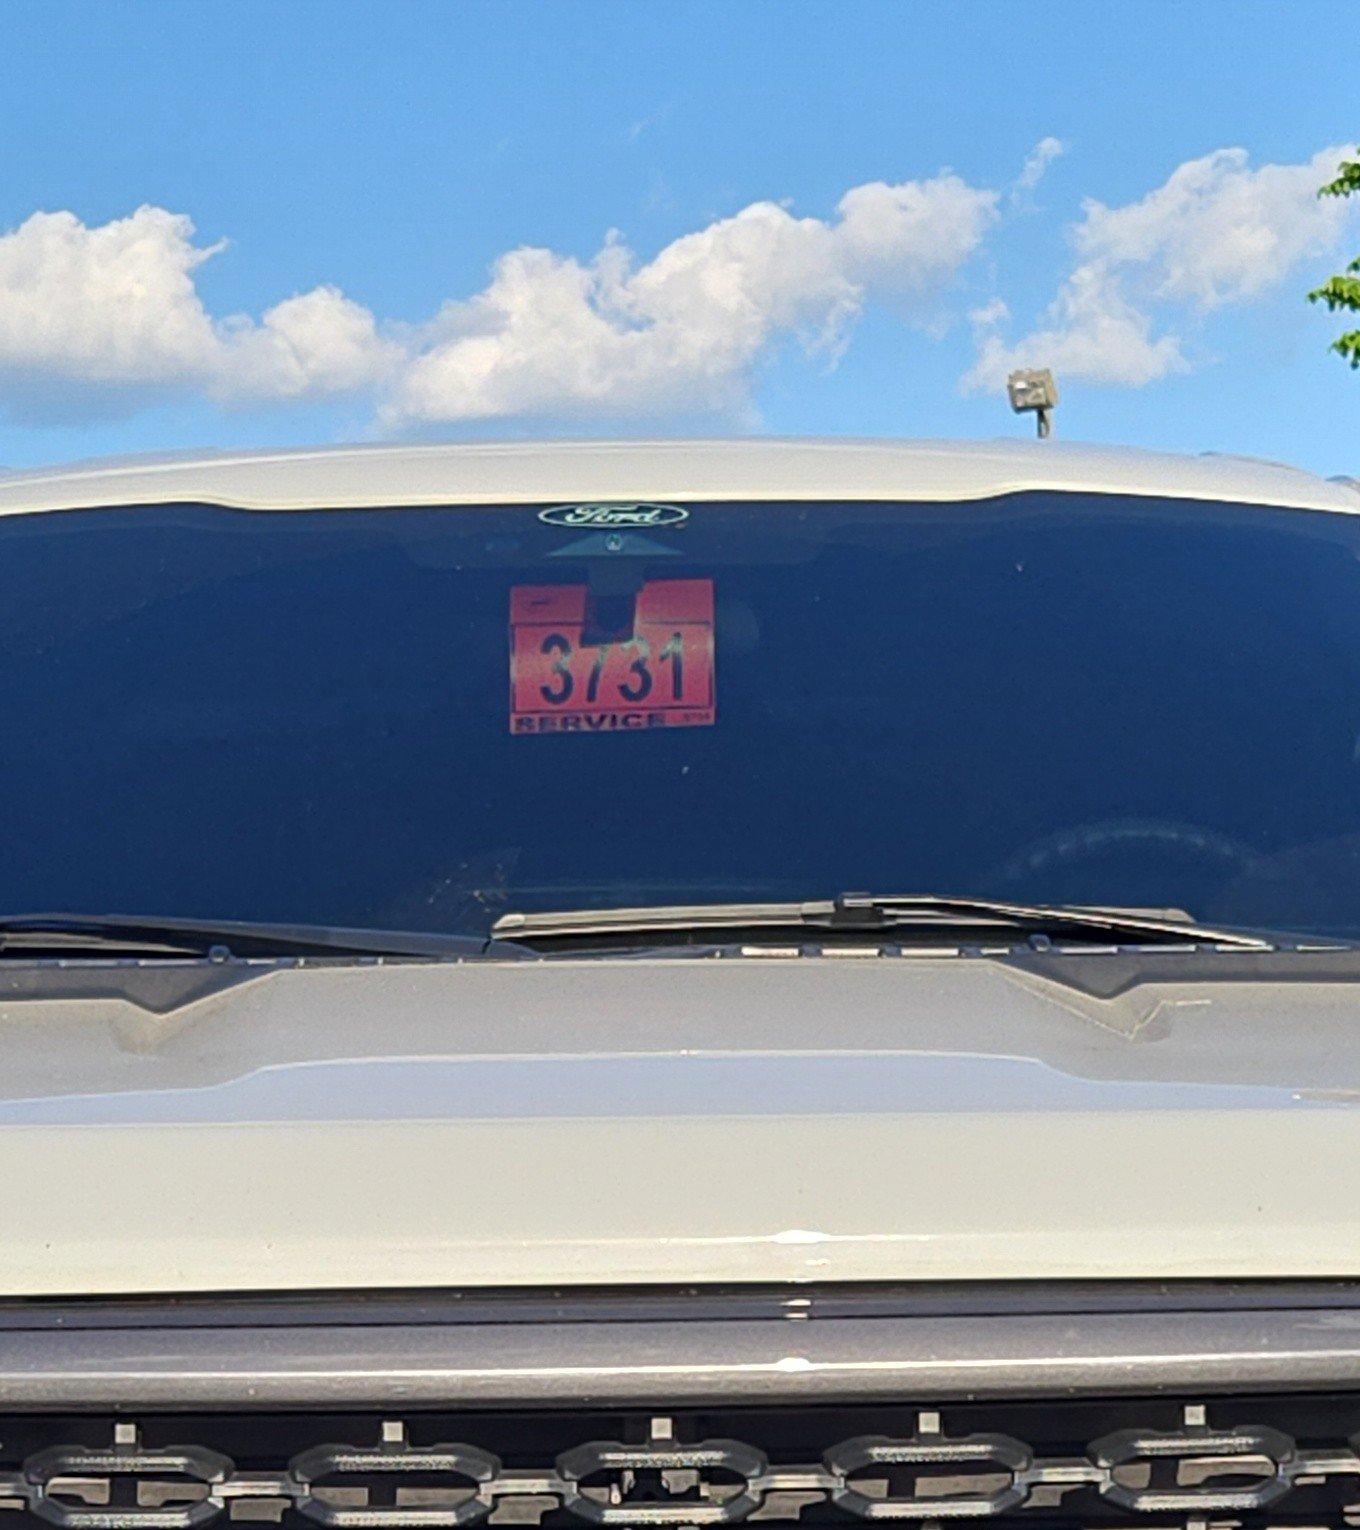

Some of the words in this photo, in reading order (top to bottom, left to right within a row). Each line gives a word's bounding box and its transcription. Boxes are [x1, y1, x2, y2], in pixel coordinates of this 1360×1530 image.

[565, 504, 661, 524] Ford
[539, 631, 683, 704] 3731
[514, 712, 666, 732] SERVICE
